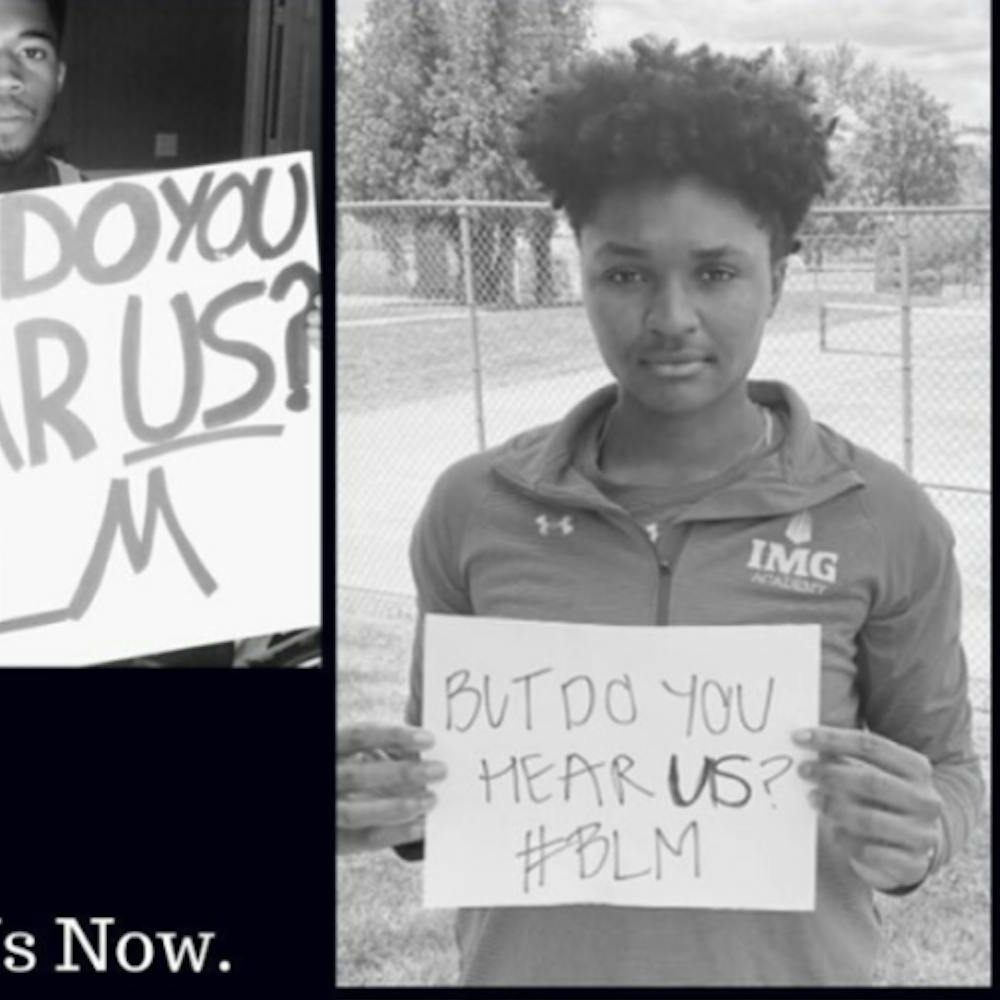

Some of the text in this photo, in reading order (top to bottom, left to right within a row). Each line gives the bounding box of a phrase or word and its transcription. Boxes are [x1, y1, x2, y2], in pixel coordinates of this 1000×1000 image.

[158, 162, 310, 262] YOU
[120, 261, 320, 444] US?
[746, 538, 839, 584] IMG
[444, 668, 776, 737] BUT DO YOU
[479, 752, 795, 810] HEAR US?
[516, 820, 703, 894] #BLM
